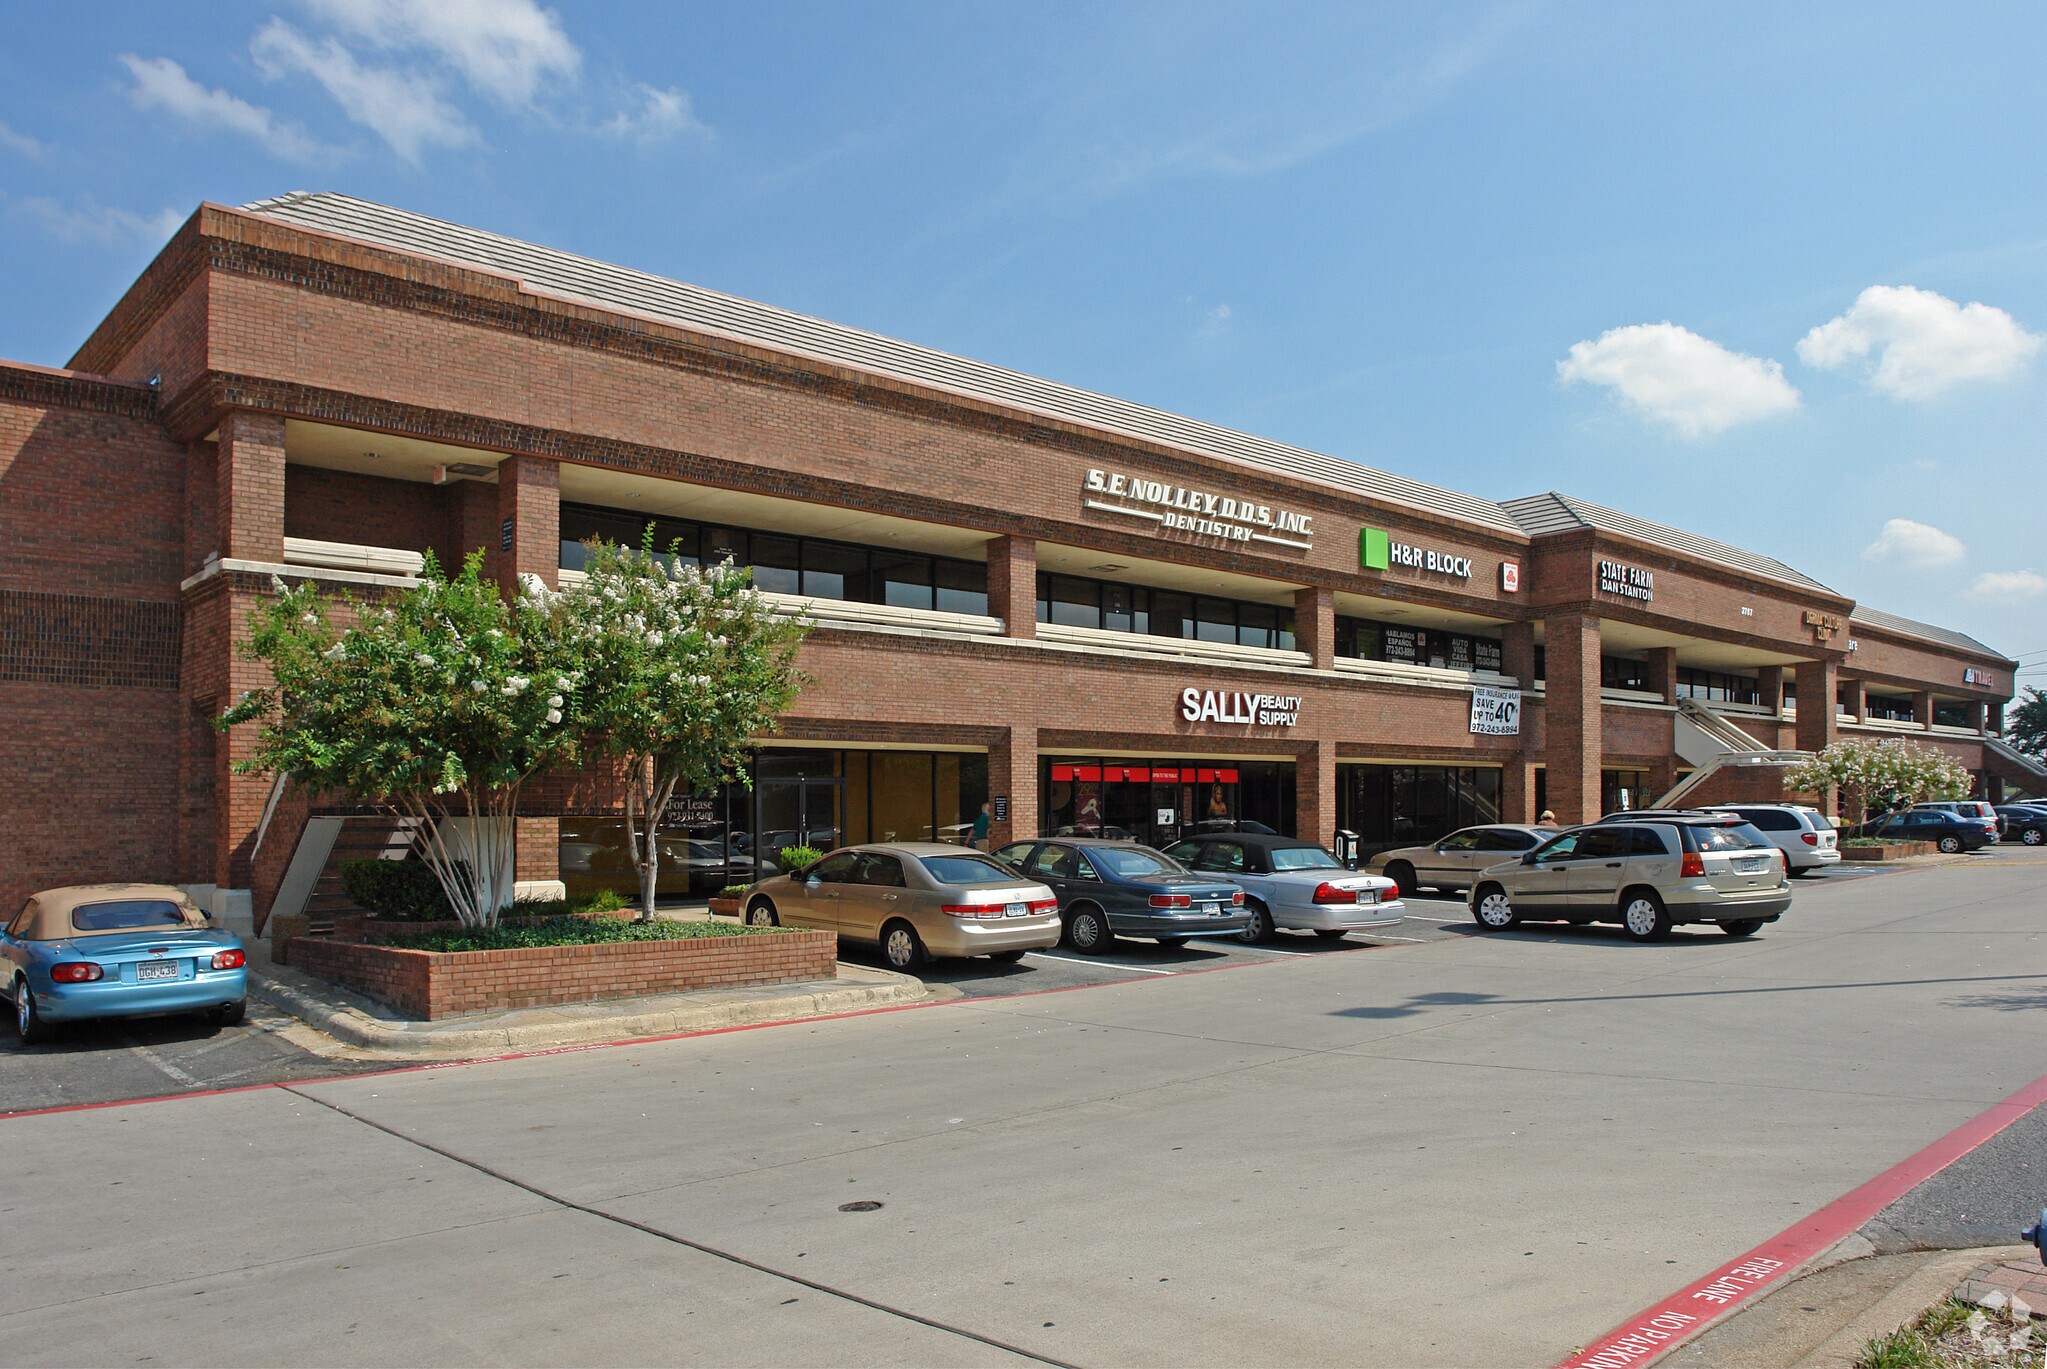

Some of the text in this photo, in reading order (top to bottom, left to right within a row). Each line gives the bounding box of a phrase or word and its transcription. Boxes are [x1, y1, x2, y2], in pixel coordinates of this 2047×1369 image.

[1161, 512, 1253, 542] DENTISTRY
[1276, 510, 1313, 535] INC.
[1390, 542, 1472, 578] H&R BLOCK
[1602, 560, 1653, 588] STATE FARM
[1602, 579, 1653, 601] DAN STANTON
[1386, 630, 1415, 640] HABLAMOS
[1388, 637, 1413, 647] ESPAÑOL
[1452, 638, 1468, 646] AUTO
[1452, 653, 1468, 661] CASA
[1453, 646, 1467, 654] VIDA
[1475, 643, 1500, 657] State Farm
[1475, 688, 1485, 696] FREE
[1486, 690, 1507, 699] INSURANCE
[1182, 687, 1261, 724] SALLY
[1260, 694, 1301, 710] BEAUTY
[1476, 698, 1495, 709] SAVE
[1259, 711, 1298, 726] SUPPLY
[1474, 710, 1494, 721] UP TO
[668, 799, 713, 810] For Lease
[1692, 1257, 1783, 1304] FIRE LANE
[1574, 1311, 1696, 1369] NO PARKIN
